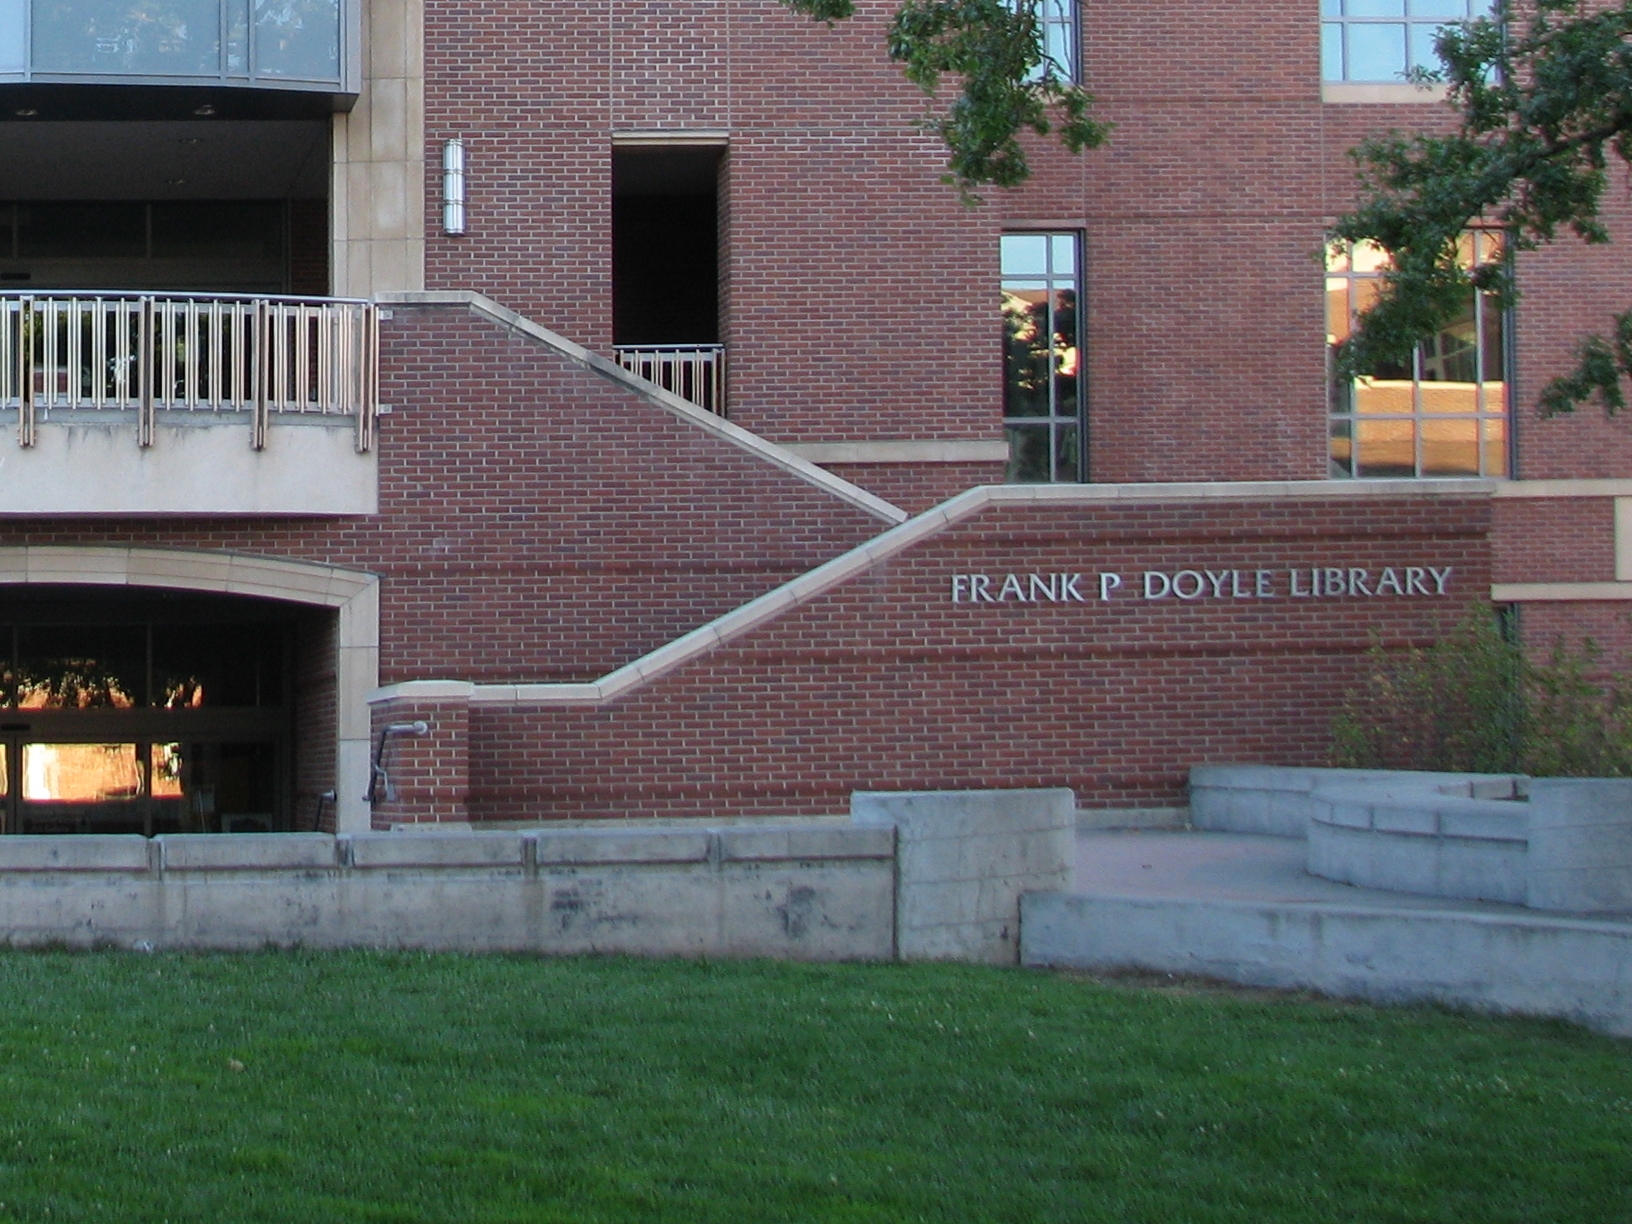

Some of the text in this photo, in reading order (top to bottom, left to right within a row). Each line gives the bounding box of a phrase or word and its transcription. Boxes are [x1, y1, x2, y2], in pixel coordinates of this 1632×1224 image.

[951, 566, 1453, 603] FRANK P DOYLE LIBRARY
